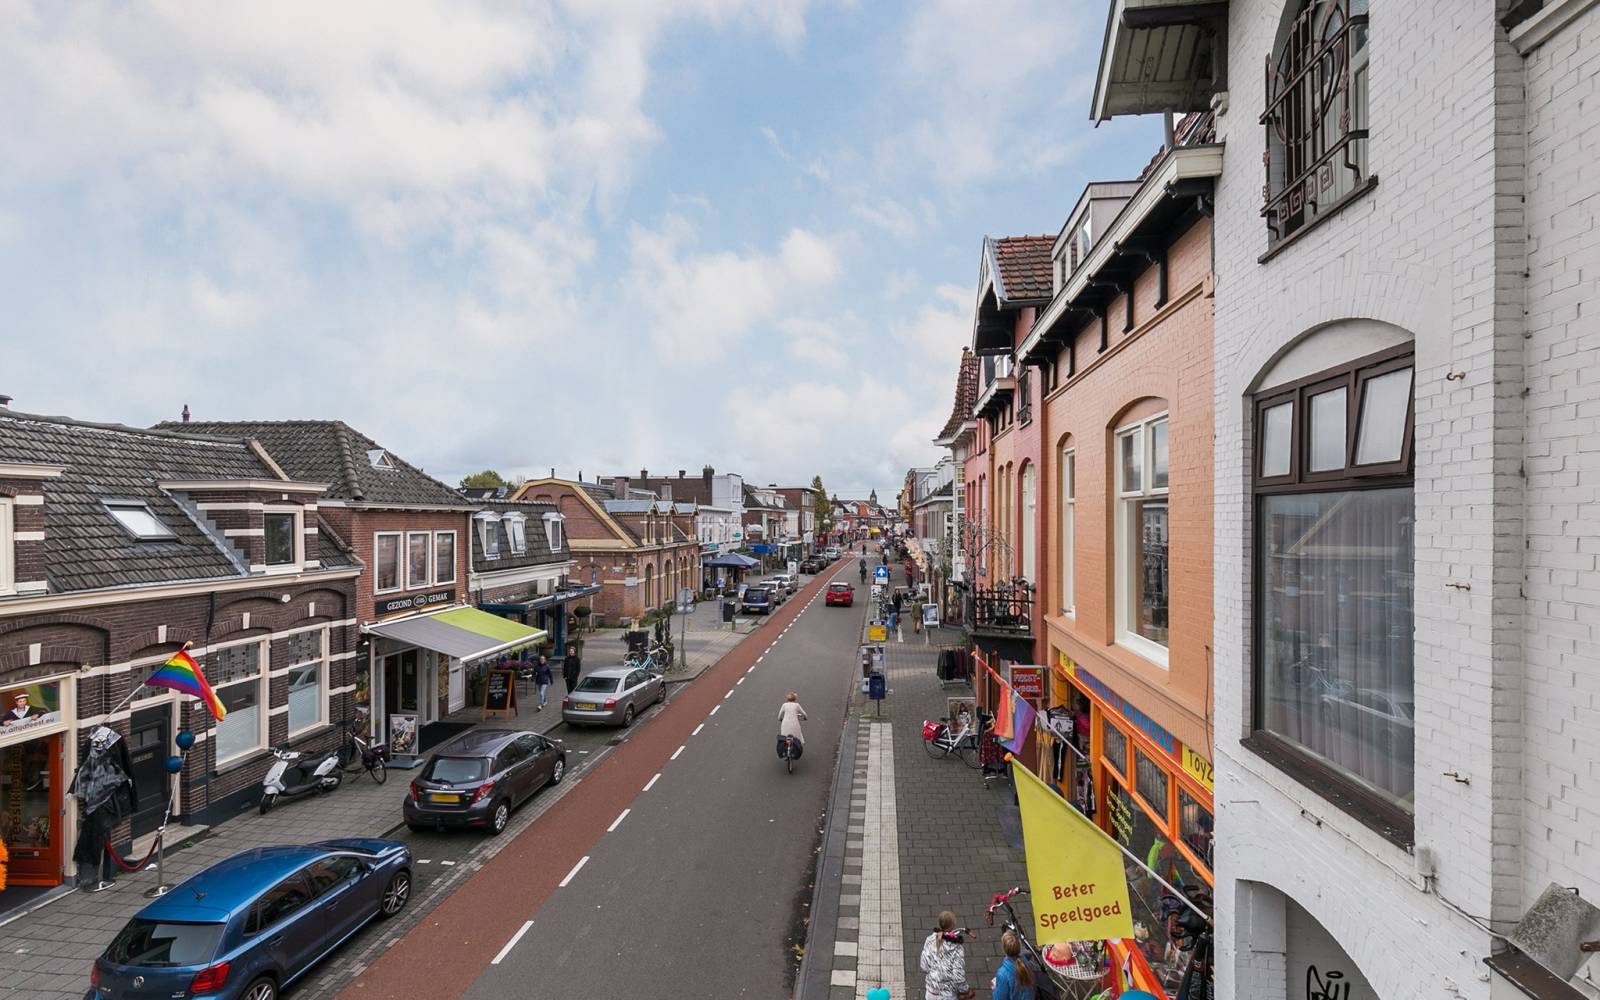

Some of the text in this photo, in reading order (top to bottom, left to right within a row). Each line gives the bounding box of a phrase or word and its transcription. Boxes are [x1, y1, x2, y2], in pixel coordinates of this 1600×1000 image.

[387, 598, 412, 611] GEZOND
[428, 592, 448, 603] GEMAK
[1052, 883, 1095, 900] Beter
[1040, 900, 1122, 929] Speelgoed
